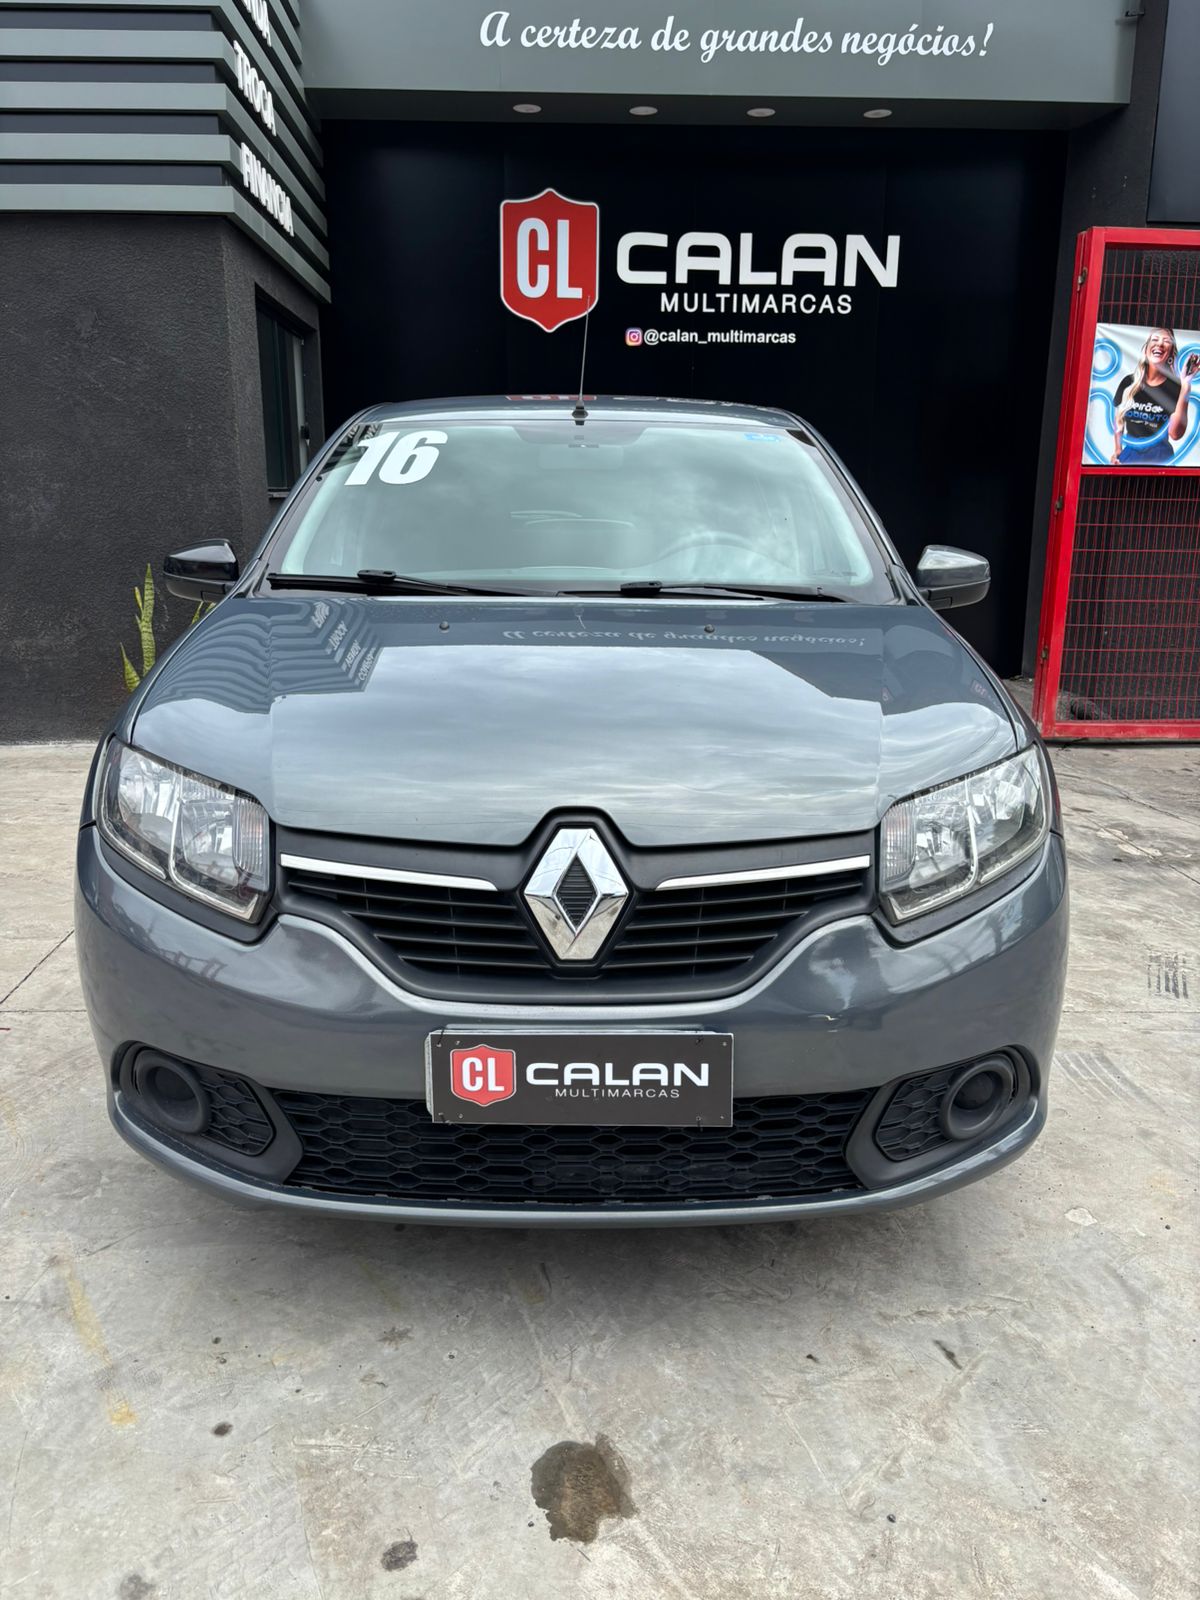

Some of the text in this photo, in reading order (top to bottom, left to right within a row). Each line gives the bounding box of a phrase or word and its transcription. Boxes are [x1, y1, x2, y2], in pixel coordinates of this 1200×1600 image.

[480, 11, 994, 66] A certeza de grandes negócios!
[233, 40, 276, 136] TROCA
[241, 142, 294, 236] FINANCIA
[516, 217, 583, 299] CL
[616, 231, 901, 288] CALAN
[660, 292, 852, 315] MULTIMARCAS
[643, 328, 797, 346] @calan_multimarcas
[344, 430, 448, 486] 16
[462, 1057, 505, 1092] CL
[525, 1062, 710, 1087] CALAN
[555, 1088, 680, 1099] MULTIMARCAS
